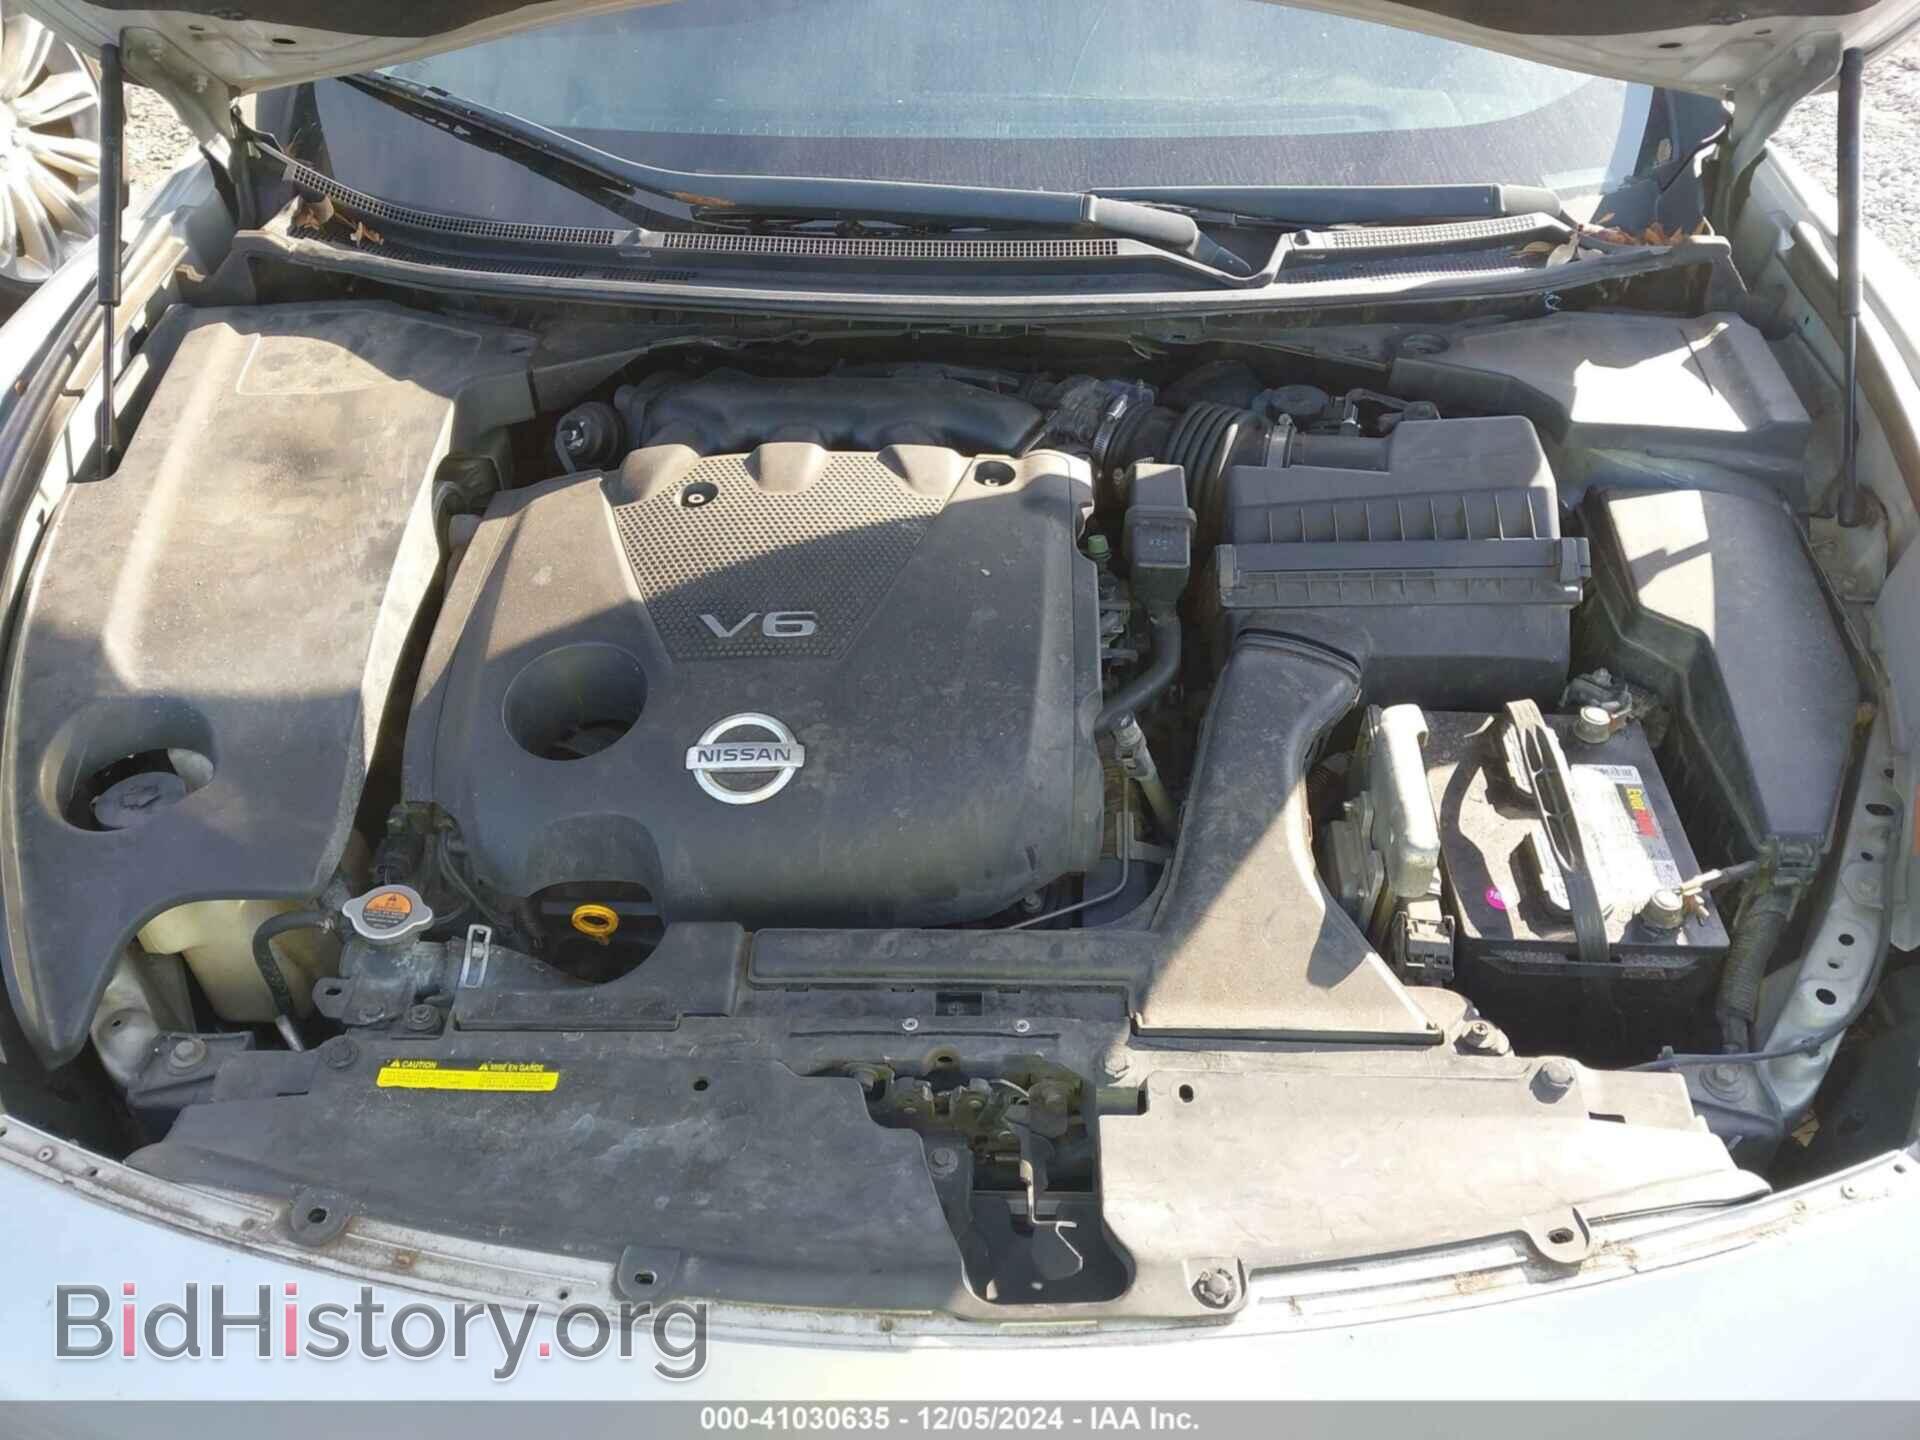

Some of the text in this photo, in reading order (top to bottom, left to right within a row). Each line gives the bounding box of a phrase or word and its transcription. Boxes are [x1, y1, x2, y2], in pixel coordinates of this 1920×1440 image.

[700, 611, 817, 638] V6
[697, 748, 790, 763] NISSAN
[401, 1060, 437, 1069] CAUTION
